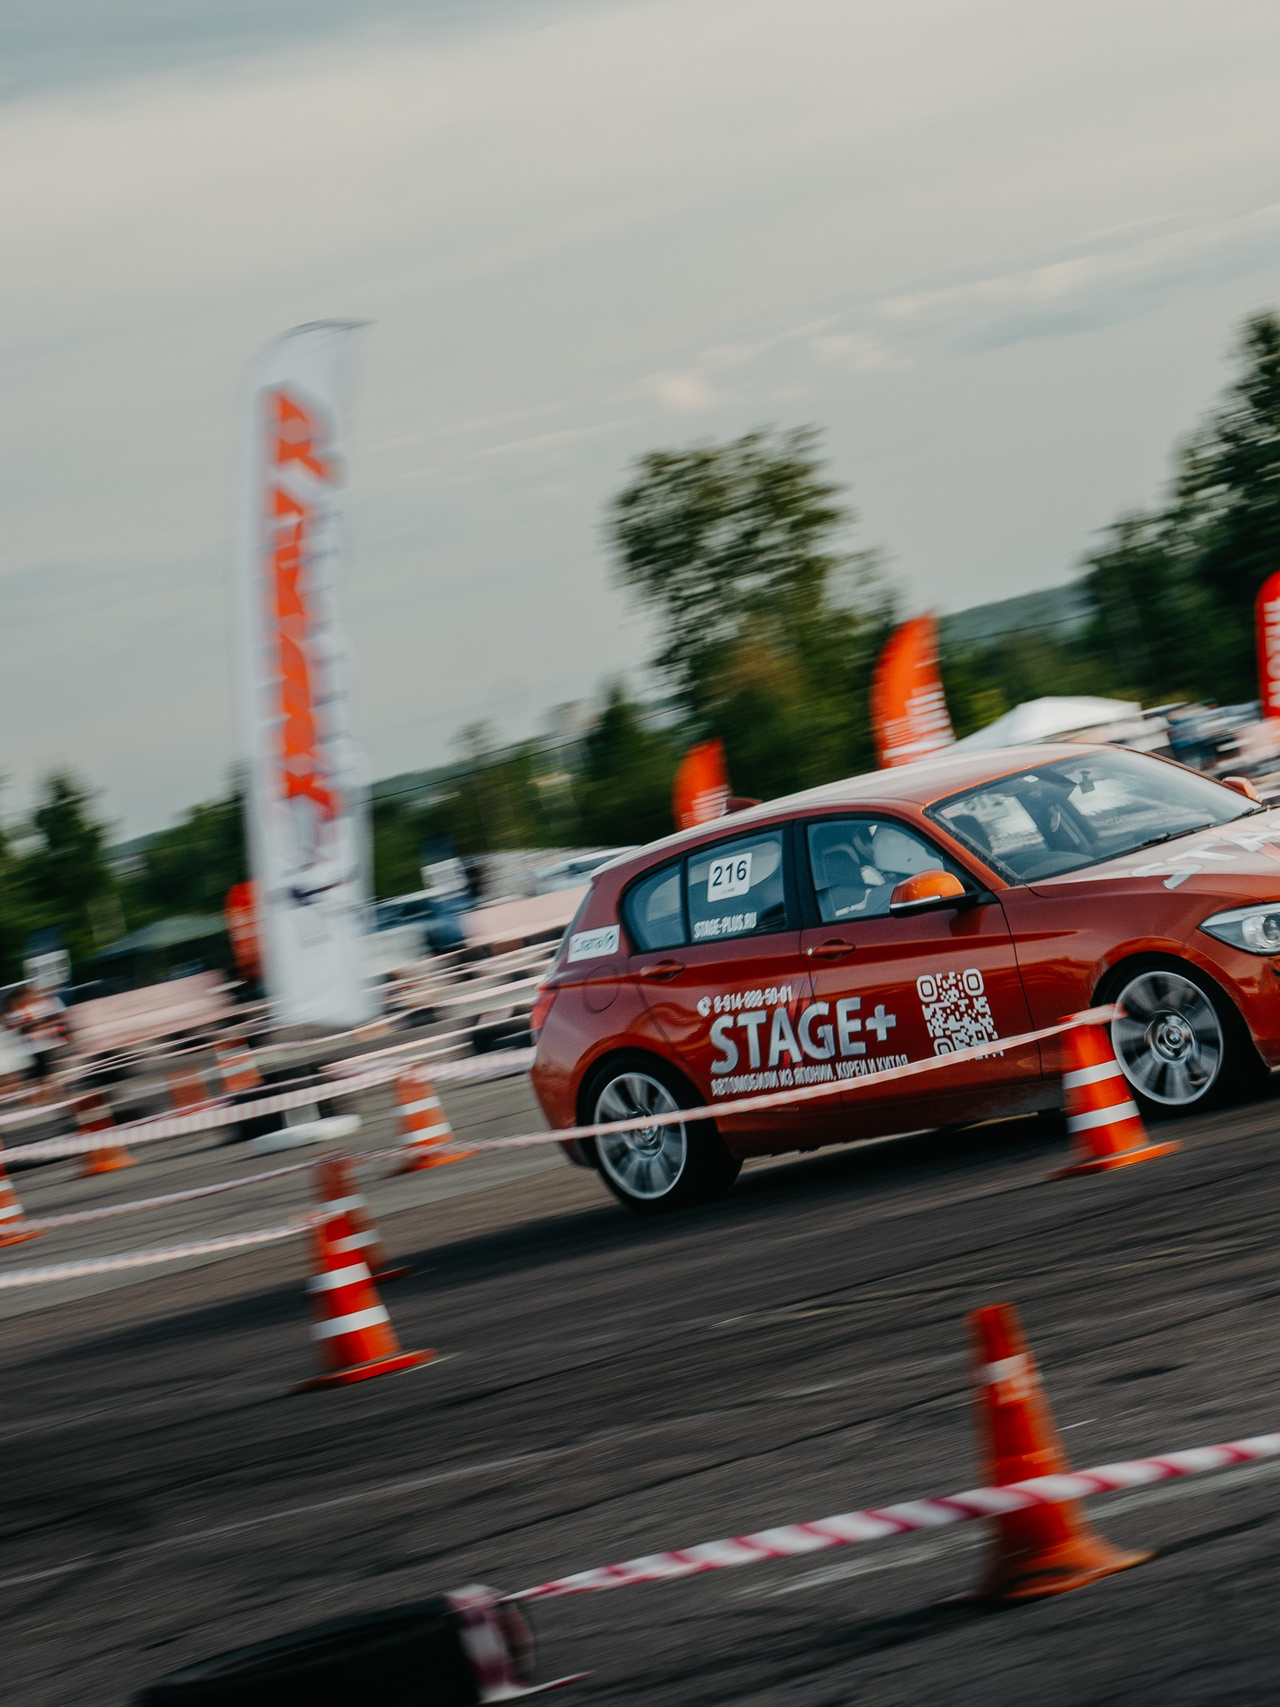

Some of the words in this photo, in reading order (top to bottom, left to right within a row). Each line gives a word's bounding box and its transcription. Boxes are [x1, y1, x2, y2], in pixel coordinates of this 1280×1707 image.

[711, 860, 747, 888] 216
[710, 996, 896, 1075] STAGE+
[711, 1070, 780, 1097] АВТОМОБИЛИ
[779, 1069, 794, 1087] ИЗ
[835, 1059, 868, 1081] КОРЕИ
